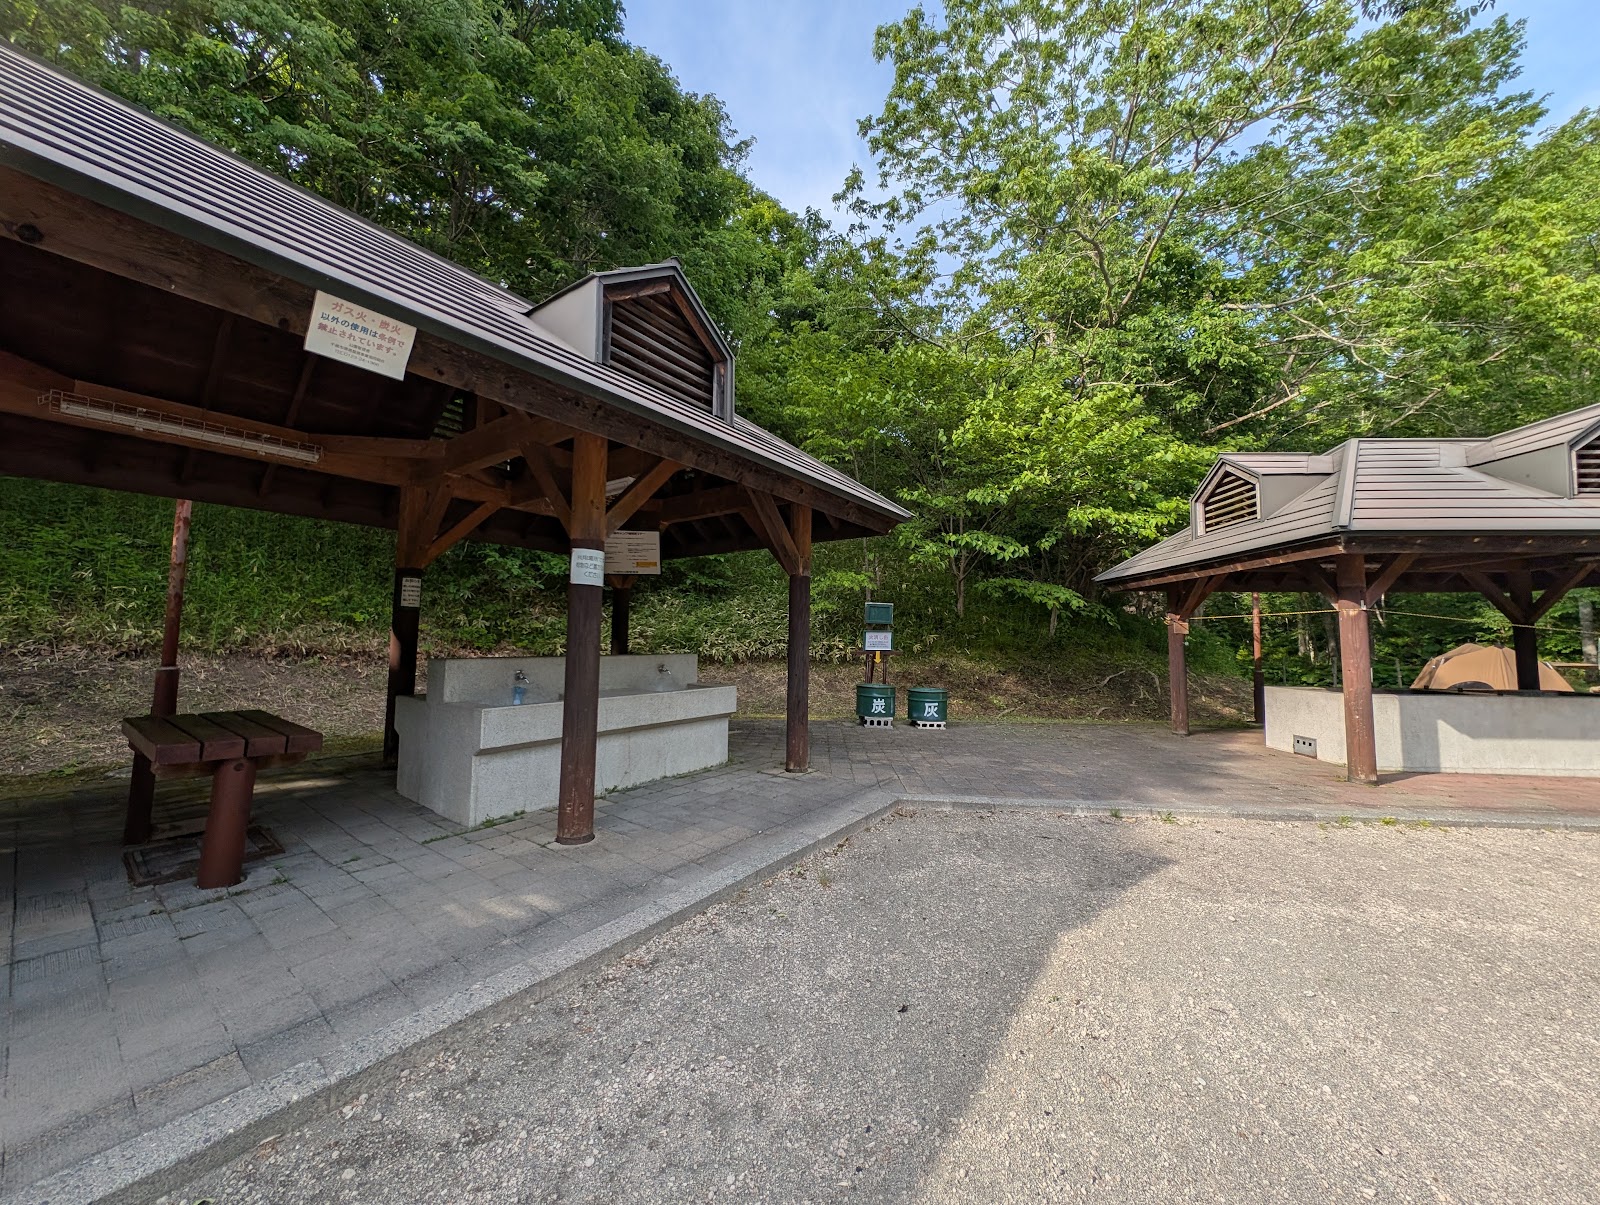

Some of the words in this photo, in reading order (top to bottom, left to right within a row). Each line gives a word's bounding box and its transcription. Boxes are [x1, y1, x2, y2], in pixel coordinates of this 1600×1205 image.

[320, 311, 405, 348] 以外の使用は条例で
[331, 302, 401, 336] ガス火・炭火
[317, 322, 397, 357] 禁止されています。
[871, 698, 886, 714] 炭
[923, 702, 939, 718] 灰
